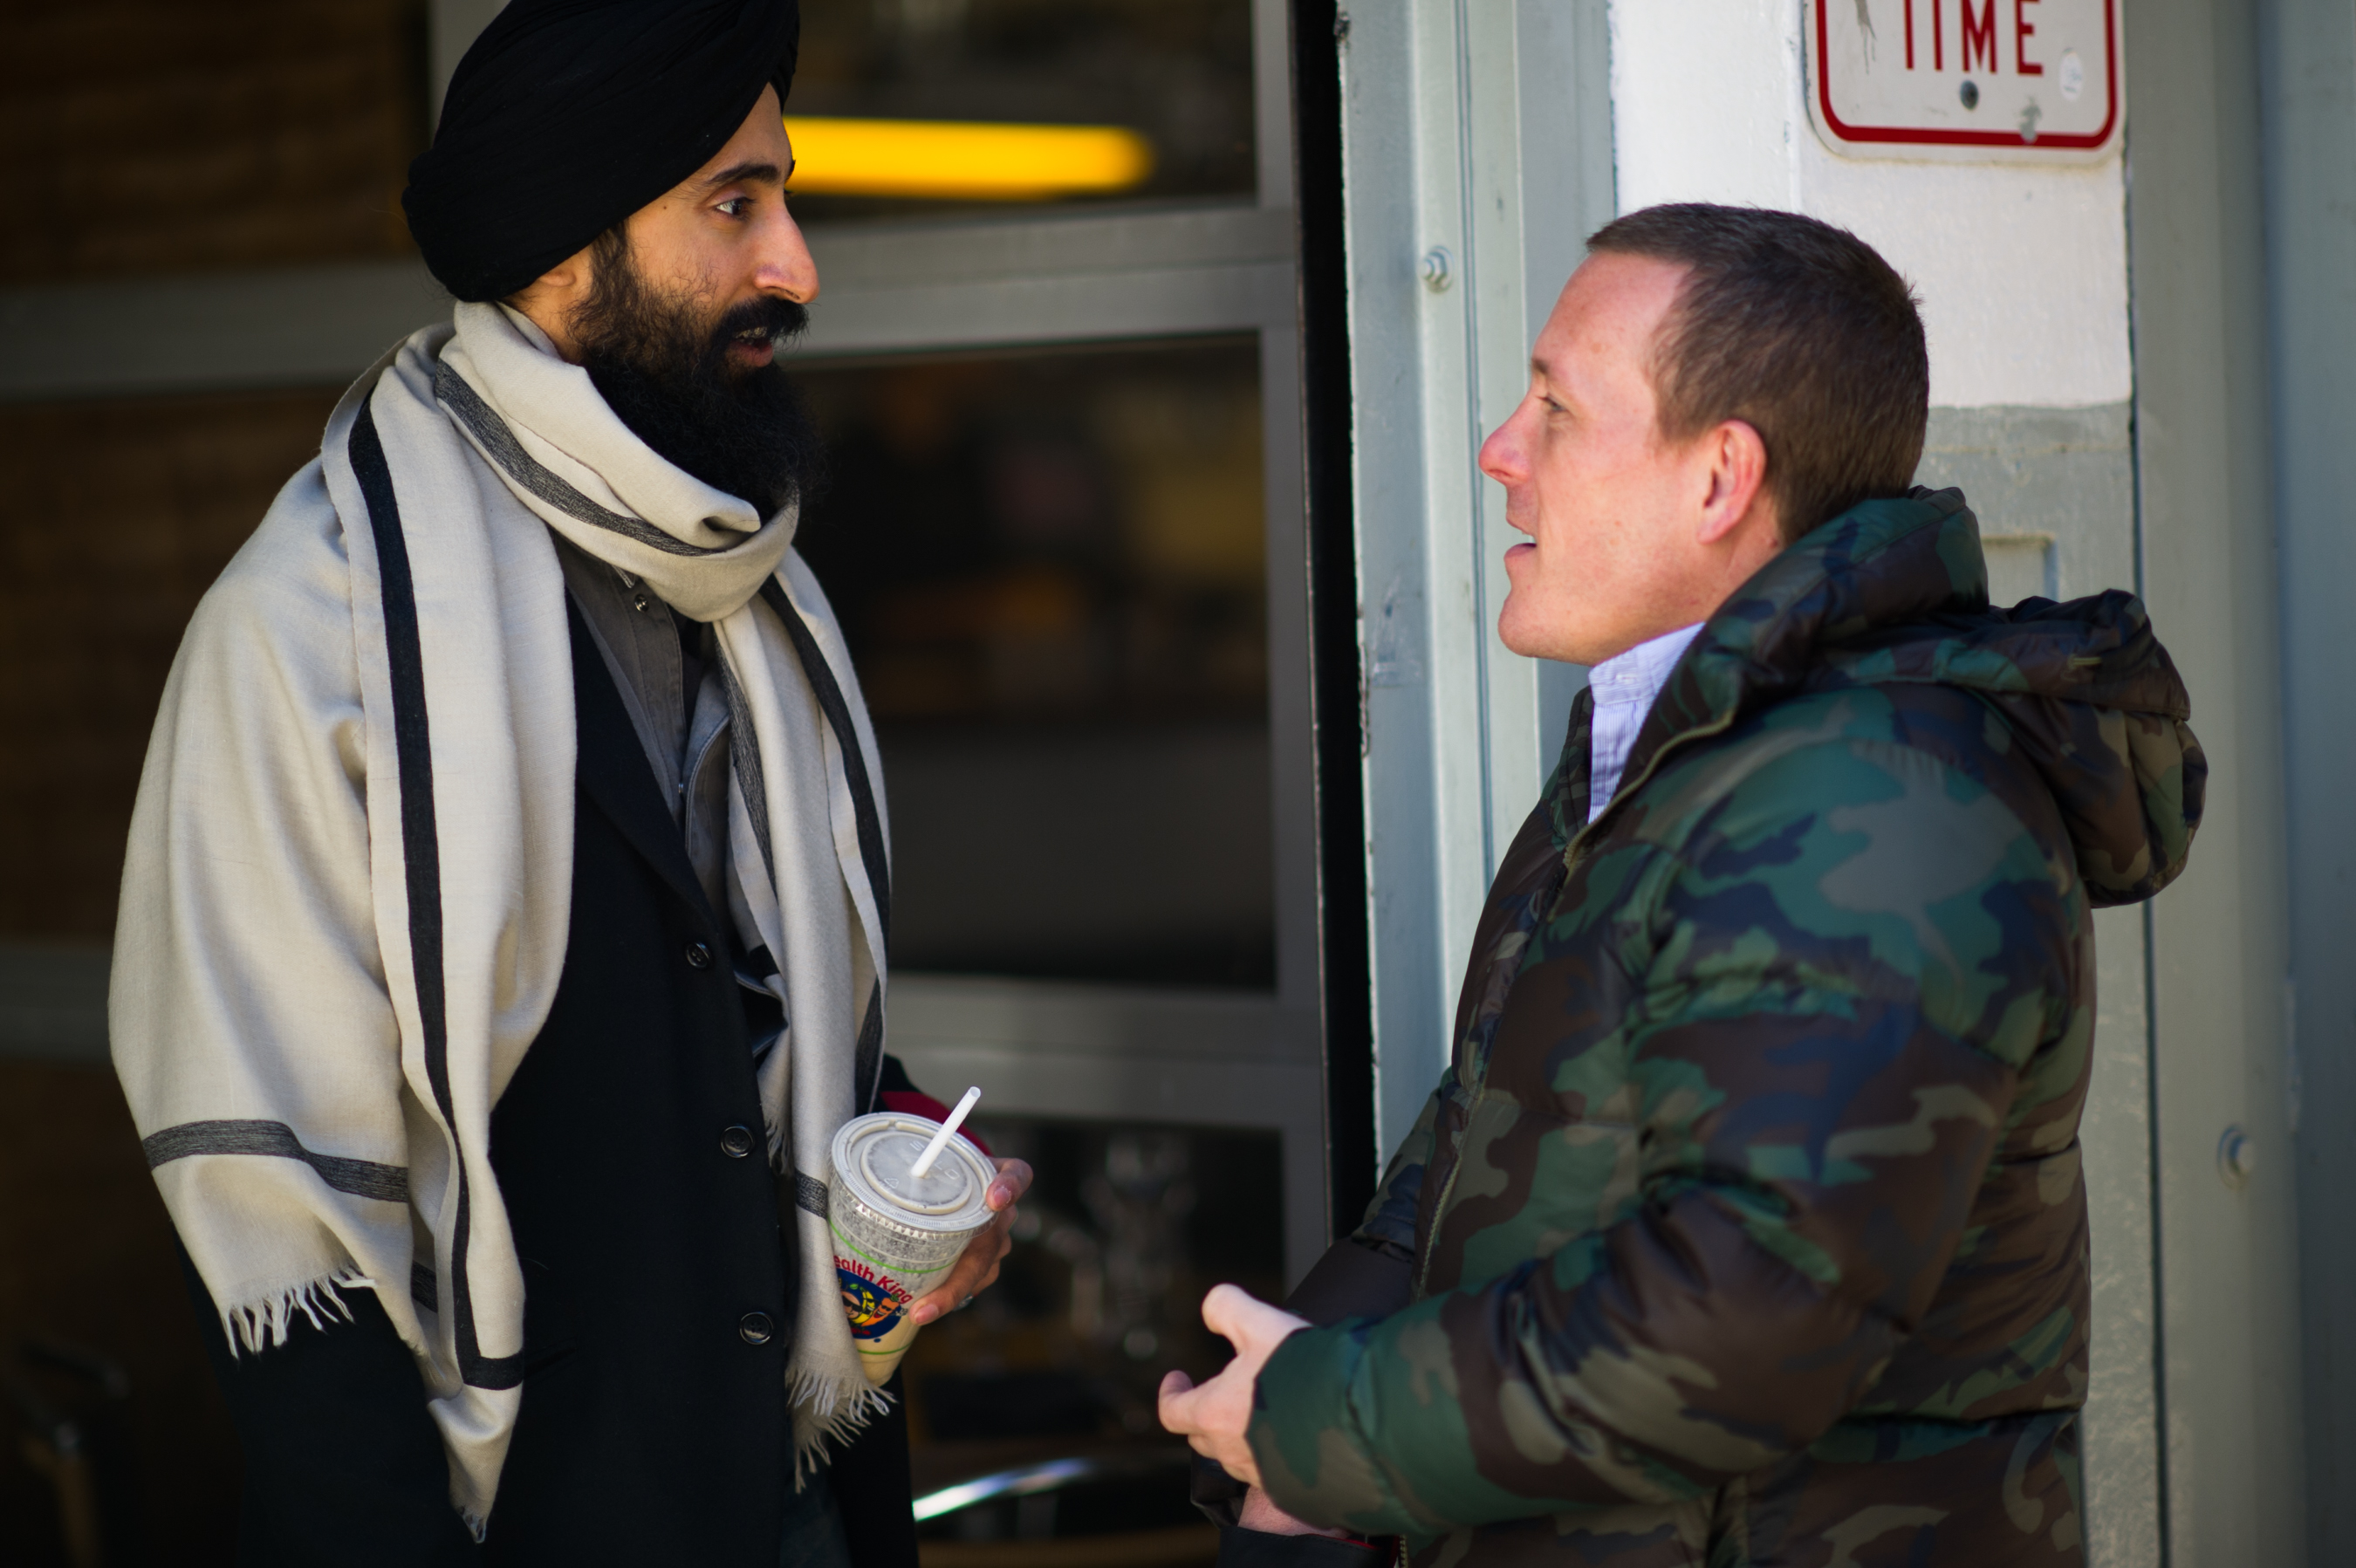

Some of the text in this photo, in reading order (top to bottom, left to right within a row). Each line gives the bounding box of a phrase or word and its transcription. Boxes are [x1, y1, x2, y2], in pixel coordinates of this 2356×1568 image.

[909, 1140, 961, 1181] SLO
[833, 1255, 914, 1305] ealth King
